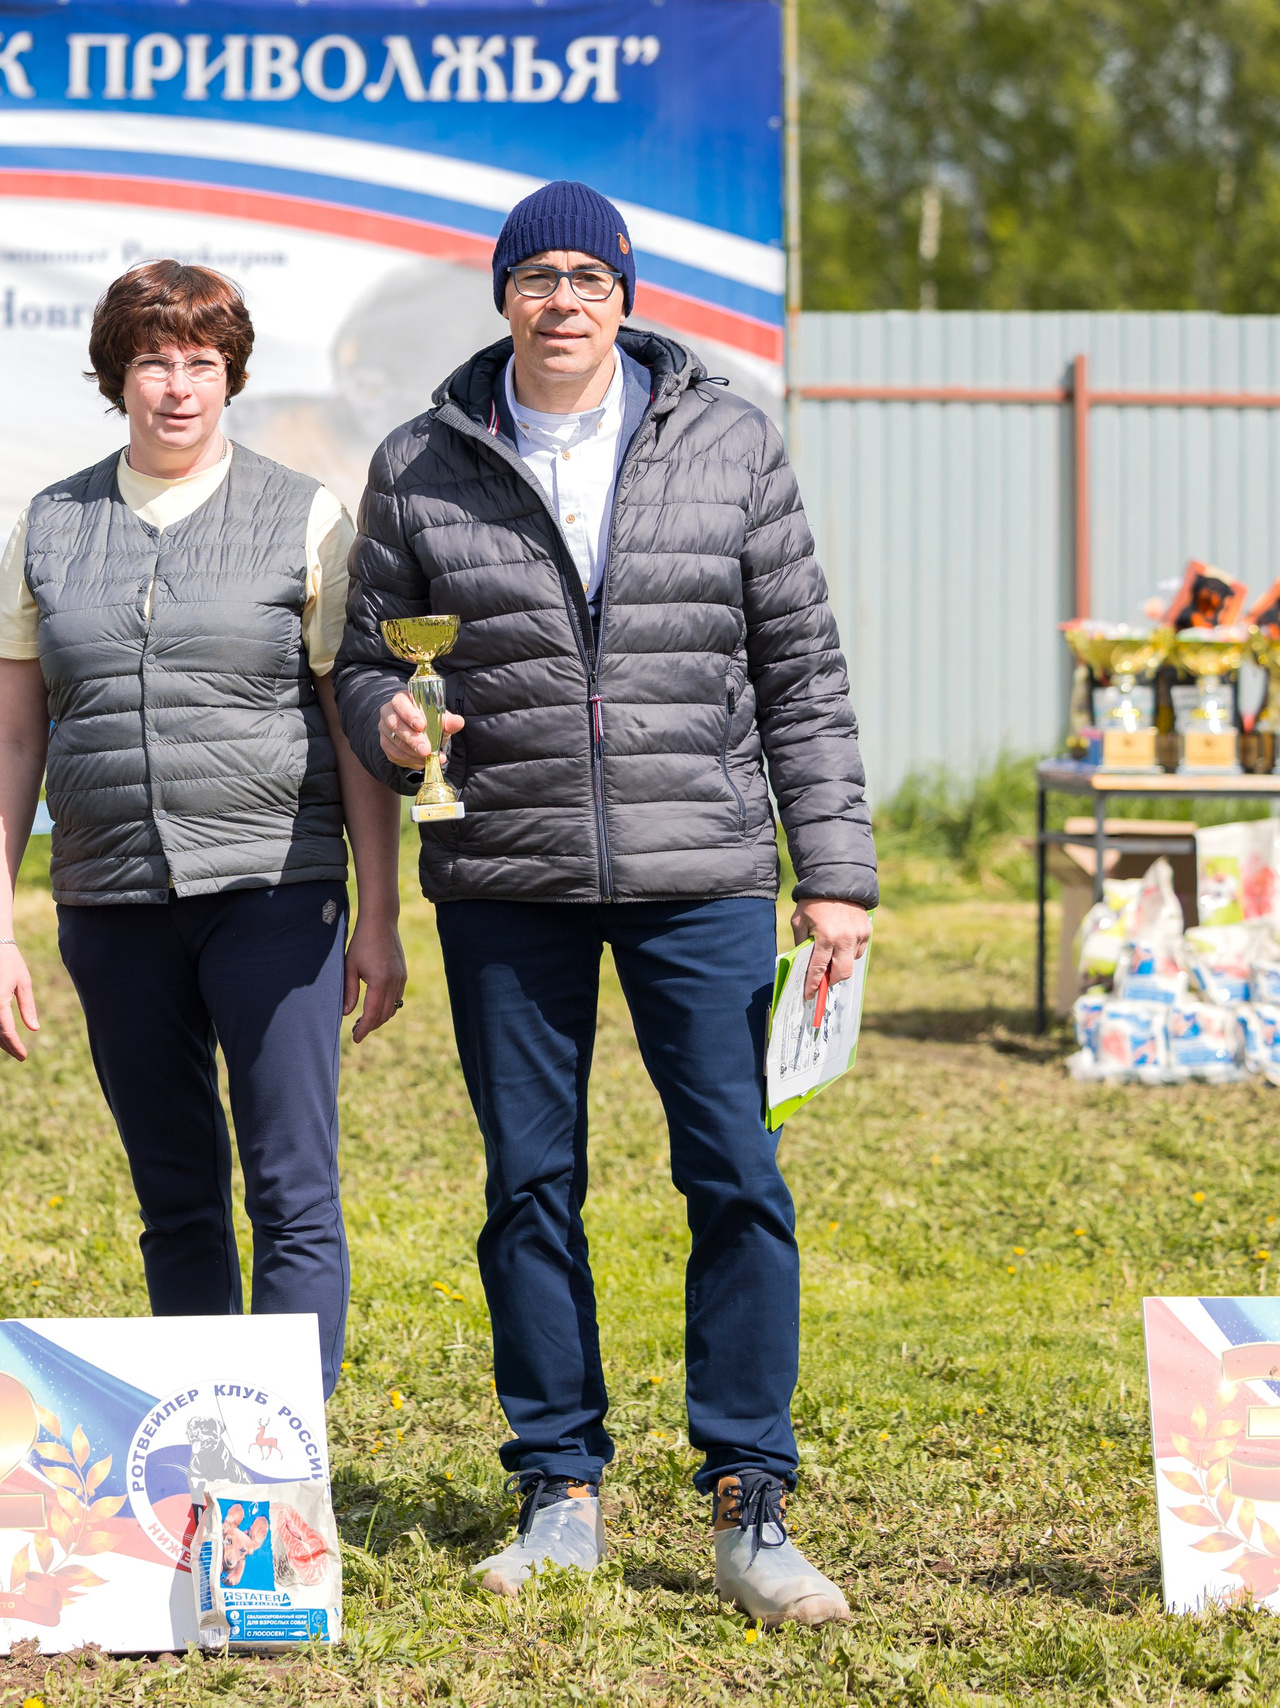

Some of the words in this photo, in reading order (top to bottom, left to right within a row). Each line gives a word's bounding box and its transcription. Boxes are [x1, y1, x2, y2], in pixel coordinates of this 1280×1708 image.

[66, 33, 660, 103] ПРИВОЛЖЬЯ”
[131, 1389, 200, 1493] РОТВЕЙЛЕР
[213, 1384, 270, 1406] КЛУБ
[147, 1521, 193, 1564] НИЖЕ
[233, 1591, 291, 1602] STATERA
